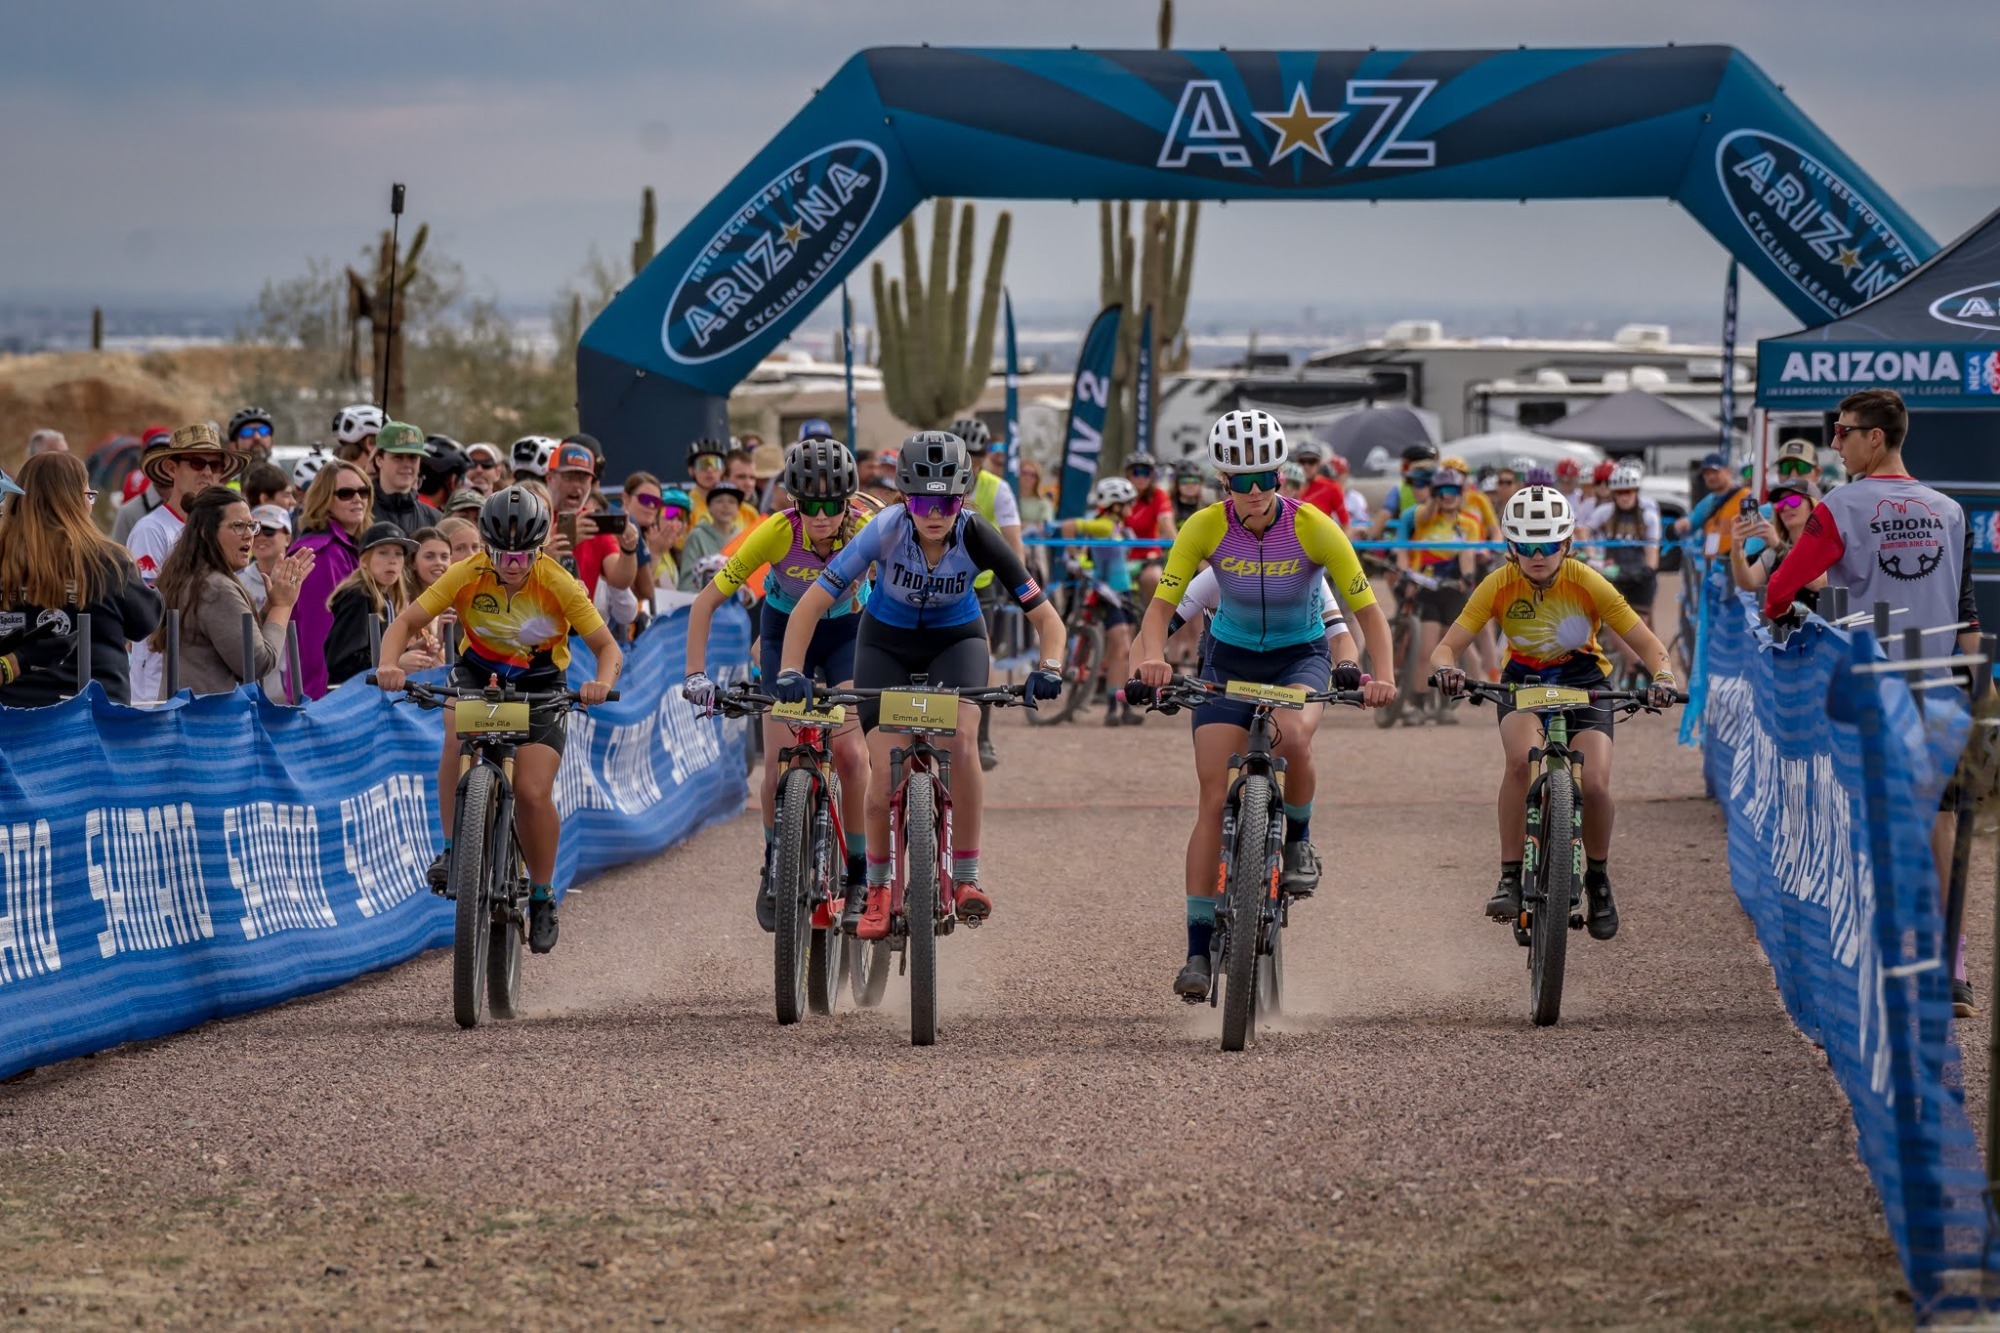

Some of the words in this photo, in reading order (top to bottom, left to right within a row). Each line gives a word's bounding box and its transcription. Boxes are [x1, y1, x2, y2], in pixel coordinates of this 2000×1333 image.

[691, 169, 805, 283] INTERSCHOLASTIC
[684, 162, 871, 348] ARIZNA
[1748, 210, 1800, 276] CYCLING
[744, 280, 809, 332] CYCLING
[808, 219, 856, 280] LEAGUE
[1780, 351, 1962, 382] ARIZONA
[1968, 355, 1980, 391] NICA
[1076, 369, 1110, 408] 2
[1870, 518, 1944, 534] SEDONA
[1886, 530, 1933, 541] SCHOOL
[1909, 540, 1923, 548] BIKE
[1220, 557, 1303, 577] CASTEEL
[912, 697, 927, 713] 4
[1239, 686, 1262, 695] Riley
[1264, 690, 1294, 699] Philips
[486, 703, 499, 719] 7
[892, 713, 919, 722] Emma
[920, 715, 945, 724] Clark
[340, 774, 436, 919] SHIMANO
[85, 801, 215, 959] SHIMANO
[224, 801, 338, 941] SHIMANO
